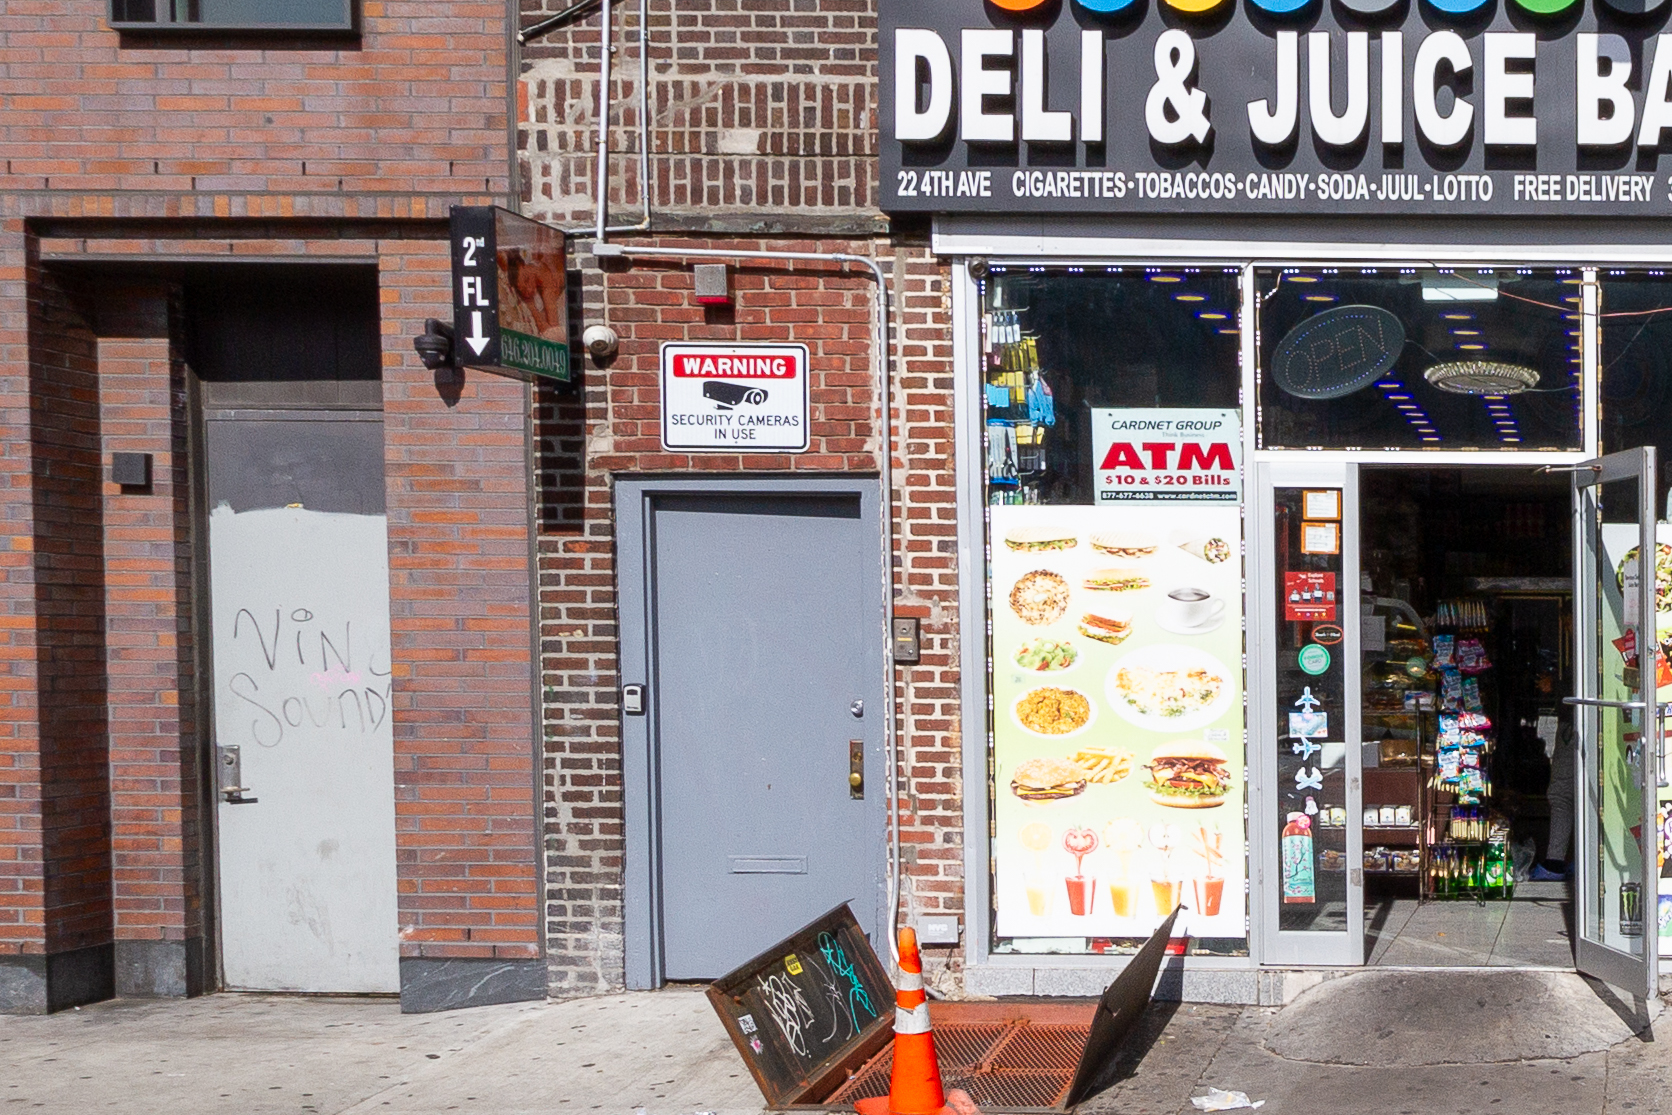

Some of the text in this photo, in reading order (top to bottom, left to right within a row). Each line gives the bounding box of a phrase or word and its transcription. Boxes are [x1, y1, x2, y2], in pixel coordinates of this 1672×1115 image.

[894, 28, 1103, 142] DELI
[1145, 28, 1211, 145] &
[1246, 29, 1537, 146] JUICE
[898, 171, 992, 197] 22 4TH AVE
[1513, 175, 1564, 202] FREE
[1566, 175, 1655, 202] DELIVERY
[462, 236, 485, 267] 2nd
[462, 275, 490, 307] FL
[1285, 313, 1388, 391] OPEN
[682, 357, 787, 376] WARNING
[671, 413, 800, 427] SECURITY CAMERAS
[1111, 420, 1223, 431] CARDNET GROUP
[714, 427, 757, 440] IN USE
[1099, 441, 1236, 471] ATM
[1105, 474, 1231, 486] $10 & $20 Bills
